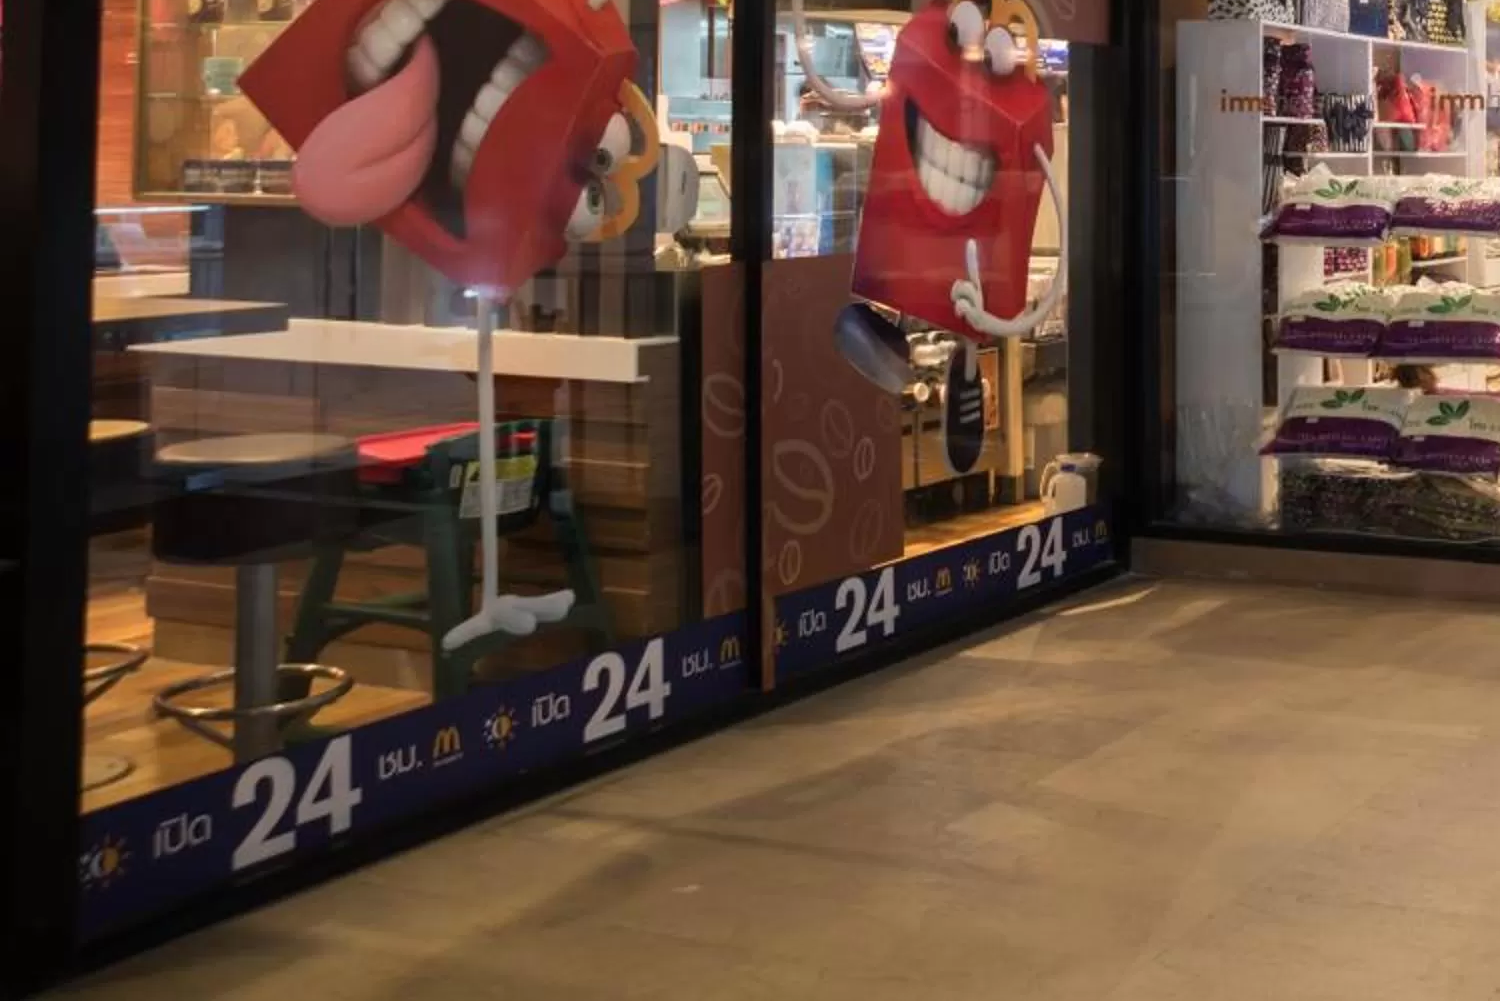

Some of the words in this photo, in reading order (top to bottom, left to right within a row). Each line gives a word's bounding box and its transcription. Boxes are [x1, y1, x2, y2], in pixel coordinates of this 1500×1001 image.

[1429, 87, 1485, 111] imm
[1016, 516, 1067, 590] 24
[835, 567, 900, 654] 24
[582, 637, 672, 743] 24
[232, 734, 362, 872] 24
